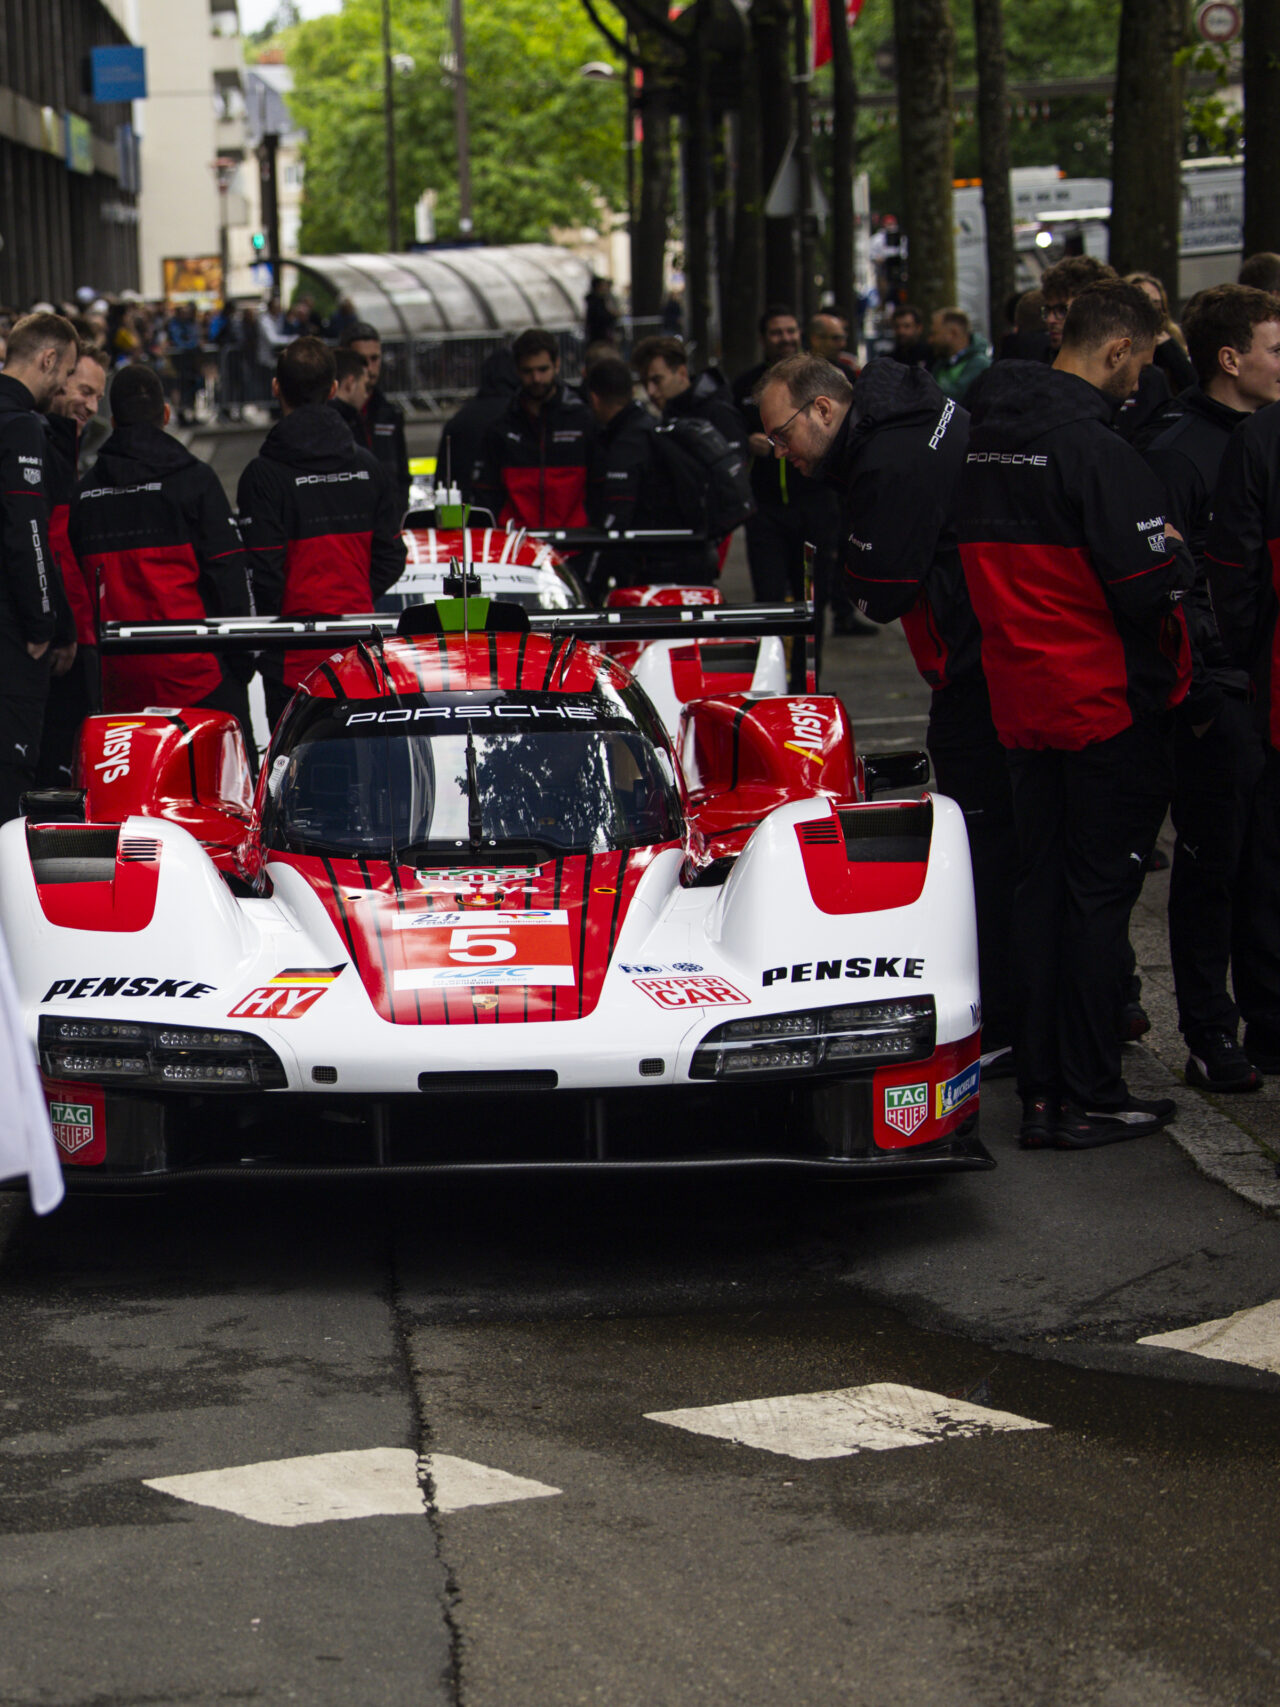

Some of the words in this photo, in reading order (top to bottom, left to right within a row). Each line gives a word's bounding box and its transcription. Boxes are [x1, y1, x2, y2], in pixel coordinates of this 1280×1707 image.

[928, 397, 956, 451] PORSCH
[966, 452, 1048, 466] PORSCHE
[80, 482, 163, 499] PORSCHE
[295, 470, 370, 487] PORSCHE
[1137, 516, 1163, 532] Mobil
[29, 519, 50, 613] PORSCHE
[346, 705, 597, 726] PORSCHE
[784, 702, 829, 766] Ansys
[94, 722, 146, 784] Ansys
[448, 927, 517, 963] 5
[641, 977, 723, 991] HYPER
[761, 957, 925, 987] PENSKE
[40, 977, 217, 1003] PENSKE
[655, 987, 741, 1006] CAR
[239, 989, 317, 1017] HY
[889, 1087, 925, 1106] TAG
[952, 1073, 976, 1101] MICHELIN
[52, 1106, 89, 1124] TAG
[888, 1106, 926, 1132] HEUER
[53, 1125, 90, 1149] HEUER
